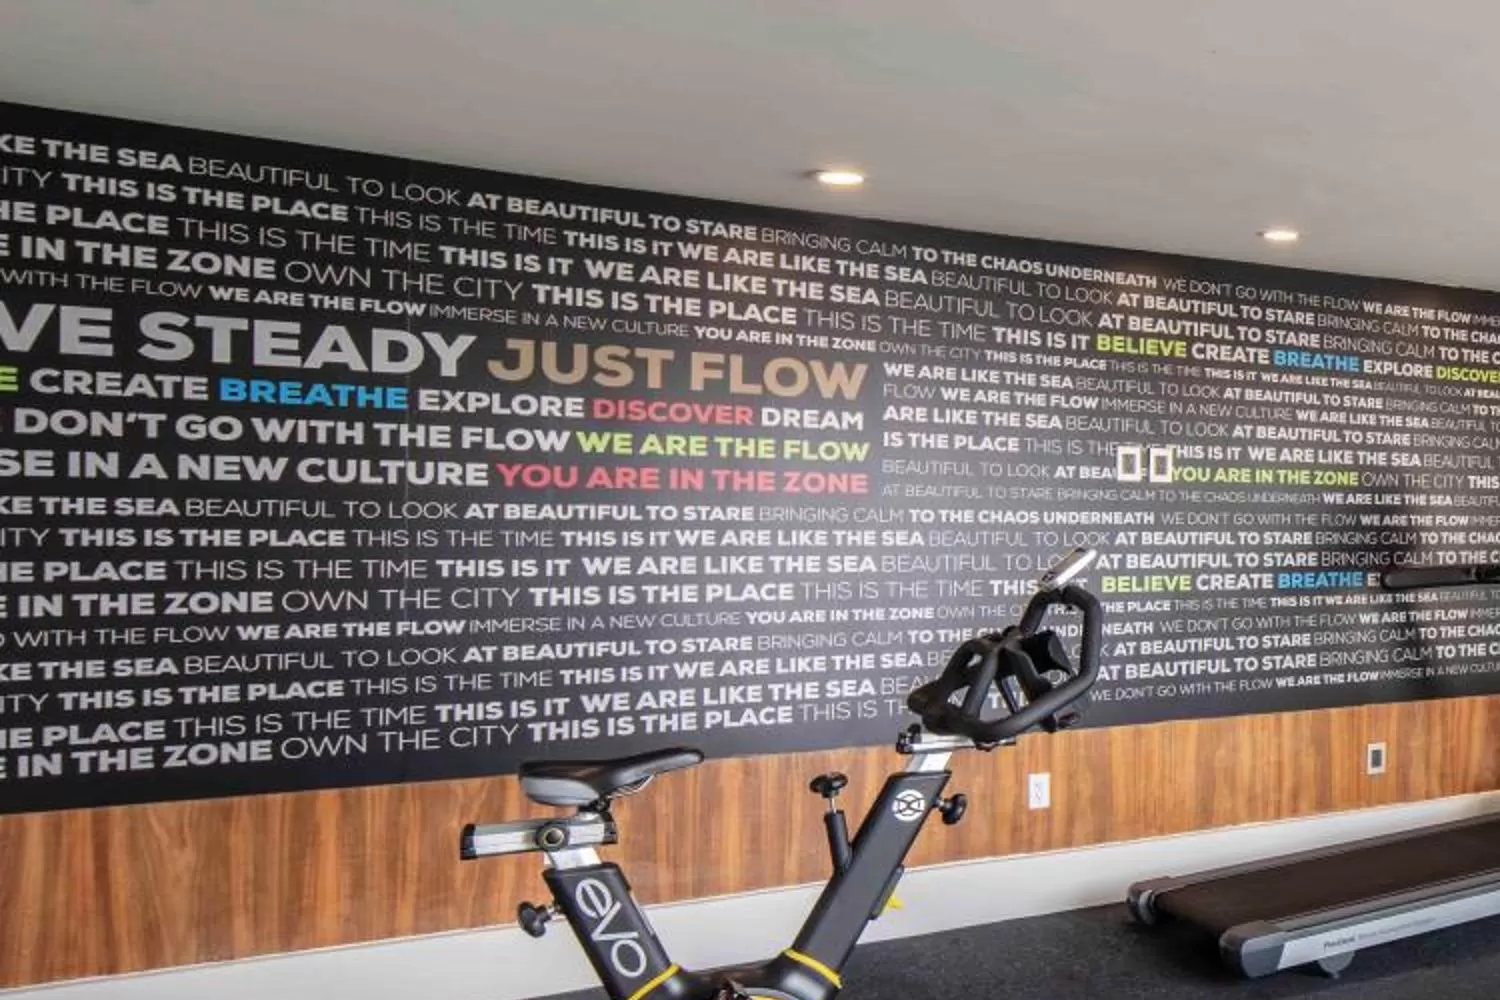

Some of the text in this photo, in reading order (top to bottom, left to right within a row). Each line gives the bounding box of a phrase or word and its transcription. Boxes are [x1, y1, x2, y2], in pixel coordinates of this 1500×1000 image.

[42, 139, 1471, 323] THE SEA BEAUTIFUL TO LOOK AT BEAUTIFUL TO STARE BRINGING CALM TO THE CHAOS UNDERNEATH WE DON'T GO WITH THE FLOW WE ARE THE FLOW
[22, 236, 65, 260] IN
[75, 240, 157, 268] THE
[167, 250, 276, 279] ZONE
[285, 261, 370, 288] OWN
[382, 269, 444, 294] THE
[454, 277, 523, 301] CITY
[532, 284, 604, 308] THIS
[612, 292, 639, 311] IS
[644, 294, 701, 317] THE
[709, 300, 796, 325] PLACE
[803, 308, 855, 331] THIS
[862, 315, 882, 333] IS
[888, 316, 931, 337] THE
[938, 322, 985, 342] TIME
[992, 327, 1041, 346] THIS
[1047, 332, 1066, 348] IS
[1072, 334, 1090, 350] IT
[1097, 334, 1186, 358] BELIEVE
[1192, 343, 1269, 364] CREATE
[1274, 350, 1359, 372] BREATHE
[1364, 360, 1433, 378] EXPLORE
[139, 312, 477, 377] STEADY
[488, 339, 675, 389] JUST
[691, 352, 868, 400] FLOW
[884, 363, 1221, 399] WE ARE LIKE THE SEA BEAUTIFUL TO LOOK
[30, 368, 208, 400] CREATE
[220, 378, 408, 409] BREATHE
[419, 389, 584, 418] EXPLORE
[594, 400, 753, 425] DISCOVER
[762, 408, 863, 431] DREAM
[15, 408, 869, 461] DON'T GO WITH THE FLOW WE ARE THE FLOW
[68, 451, 118, 478] IN
[129, 454, 168, 479] A
[178, 454, 288, 481] NEW
[297, 458, 488, 486] CULTURE
[497, 464, 578, 488] YOU
[587, 467, 660, 490] ARE
[670, 469, 704, 490] IN
[712, 470, 776, 492] THE
[784, 472, 867, 493] ZONE
[1168, 464, 1210, 483] YOU
[1214, 468, 1251, 483] ARE
[1256, 469, 1281, 483] IN
[1283, 470, 1310, 484] THE
[1313, 470, 1358, 485] ZONE
[1361, 472, 1399, 486] OWN
[1403, 473, 1432, 489] THE
[1433, 473, 1464, 489] CITY
[1468, 476, 1500, 488] THIS
[1095, 552, 1318, 569] AT BEAUTIFUL TO STARE
[1102, 572, 1362, 592] BELIEVE CREATE BREATHE
[14, 620, 466, 647] WITH THE FLOW WE ARE THE FLOW
[58, 652, 924, 710] THIS IS THE PLACE THIS IS THE TIME THIS IS IT WE ARE LIKE THE SEA
[18, 699, 877, 777] IN THE ZONE OWN THE CITY THIS IS THE PLACE THIS IS
